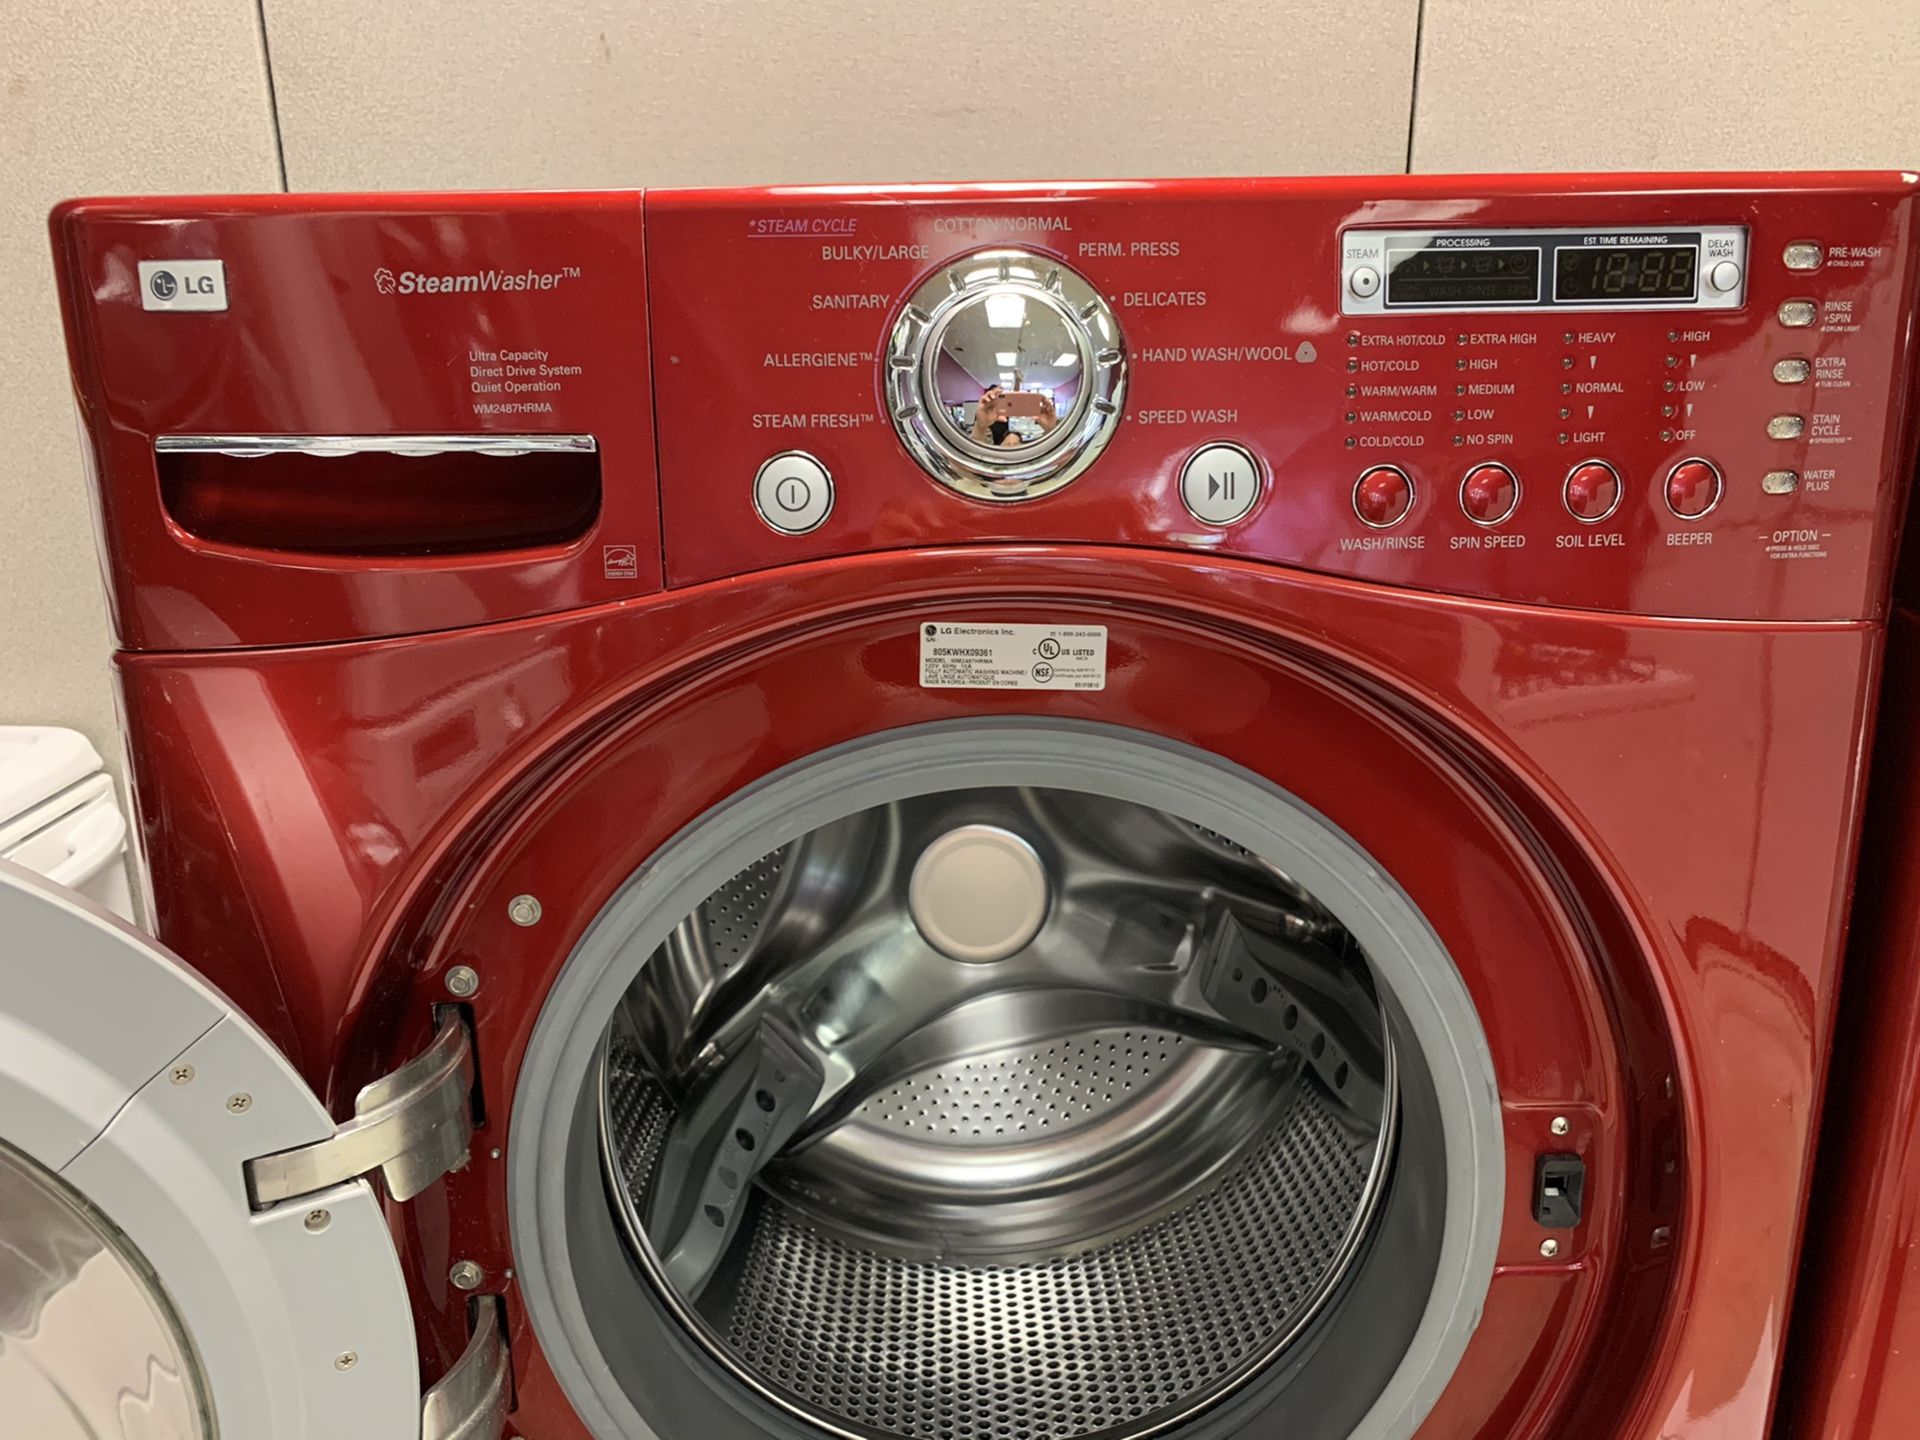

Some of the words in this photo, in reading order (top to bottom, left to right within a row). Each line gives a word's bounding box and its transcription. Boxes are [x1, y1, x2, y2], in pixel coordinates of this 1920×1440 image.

[812, 218, 857, 233] CYCLE
[1436, 238, 1491, 247] PROCESSING
[1599, 236, 1618, 245] TIME
[1619, 235, 1668, 245] REMAINING
[1707, 239, 1735, 248] DELAY
[822, 245, 929, 261] BULKY/LARGE
[1078, 243, 1126, 257] PERM.
[1131, 242, 1180, 257] PRESS
[1346, 248, 1379, 260] STEAM
[1708, 248, 1734, 257] WASH
[1828, 247, 1882, 258] PRE-WASH
[184, 275, 215, 294] LG
[812, 294, 890, 309] SANITARY
[1123, 291, 1207, 307] DELICATES
[1824, 301, 1853, 312] RINSE
[1823, 313, 1851, 324] +SPIN
[1361, 335, 1394, 346] EXTRA
[1396, 334, 1446, 346] HOT/COLD
[1470, 333, 1507, 345] EXTRA
[1509, 333, 1537, 344] HIGH
[1578, 332, 1617, 344] HEAVY
[1683, 331, 1711, 341] HIGH
[469, 350, 497, 362] Ultra
[500, 349, 549, 363] Capacity
[1142, 348, 1187, 362] HAND
[1191, 346, 1292, 362] WASH/WOOL
[1360, 360, 1419, 372] HOT/COLD
[1469, 359, 1498, 370] HIGH
[1815, 357, 1846, 368] EXTRA
[470, 366, 504, 378] Direct
[506, 365, 536, 377] Drive
[539, 364, 582, 378] System
[1816, 368, 1844, 379] RINSE
[471, 381, 501, 394] Quiet
[505, 380, 561, 394] Operation
[1360, 385, 1438, 397] WARM/WARM
[1468, 384, 1515, 395] MEDIUM
[1576, 382, 1625, 393] NORMAL
[1679, 380, 1706, 391] LOW
[472, 403, 553, 415] WM2487HRMA
[1467, 409, 1494, 420] LOW
[752, 414, 806, 428] STEAM
[1138, 410, 1187, 425] SPEED
[1191, 409, 1239, 424] WASH
[1360, 410, 1432, 422] WARM/COLD
[1812, 414, 1841, 425] STAIN
[1675, 429, 1697, 441] OFF
[1811, 425, 1841, 436] CYCLE
[1359, 435, 1425, 447] COLD/COLD
[1466, 434, 1484, 445] NO
[1487, 433, 1514, 445] SPIN
[1573, 432, 1606, 443] LIGHT
[1803, 469, 1836, 480] WATER
[1805, 481, 1830, 492] PLUS
[1450, 535, 1481, 550] SPIN
[1483, 534, 1527, 549] SPEED
[1555, 534, 1584, 548] SOIL
[1586, 533, 1626, 547] LEVEL
[1666, 532, 1713, 546] BEEPER
[1772, 529, 1818, 543] OPTION
[1340, 535, 1426, 551] WASH/RINSE
[940, 627, 952, 635] LG
[954, 627, 999, 635] Electronics
[1001, 628, 1015, 636] Inc.
[1061, 648, 1070, 656] US
[1072, 648, 1095, 656] LISTED
